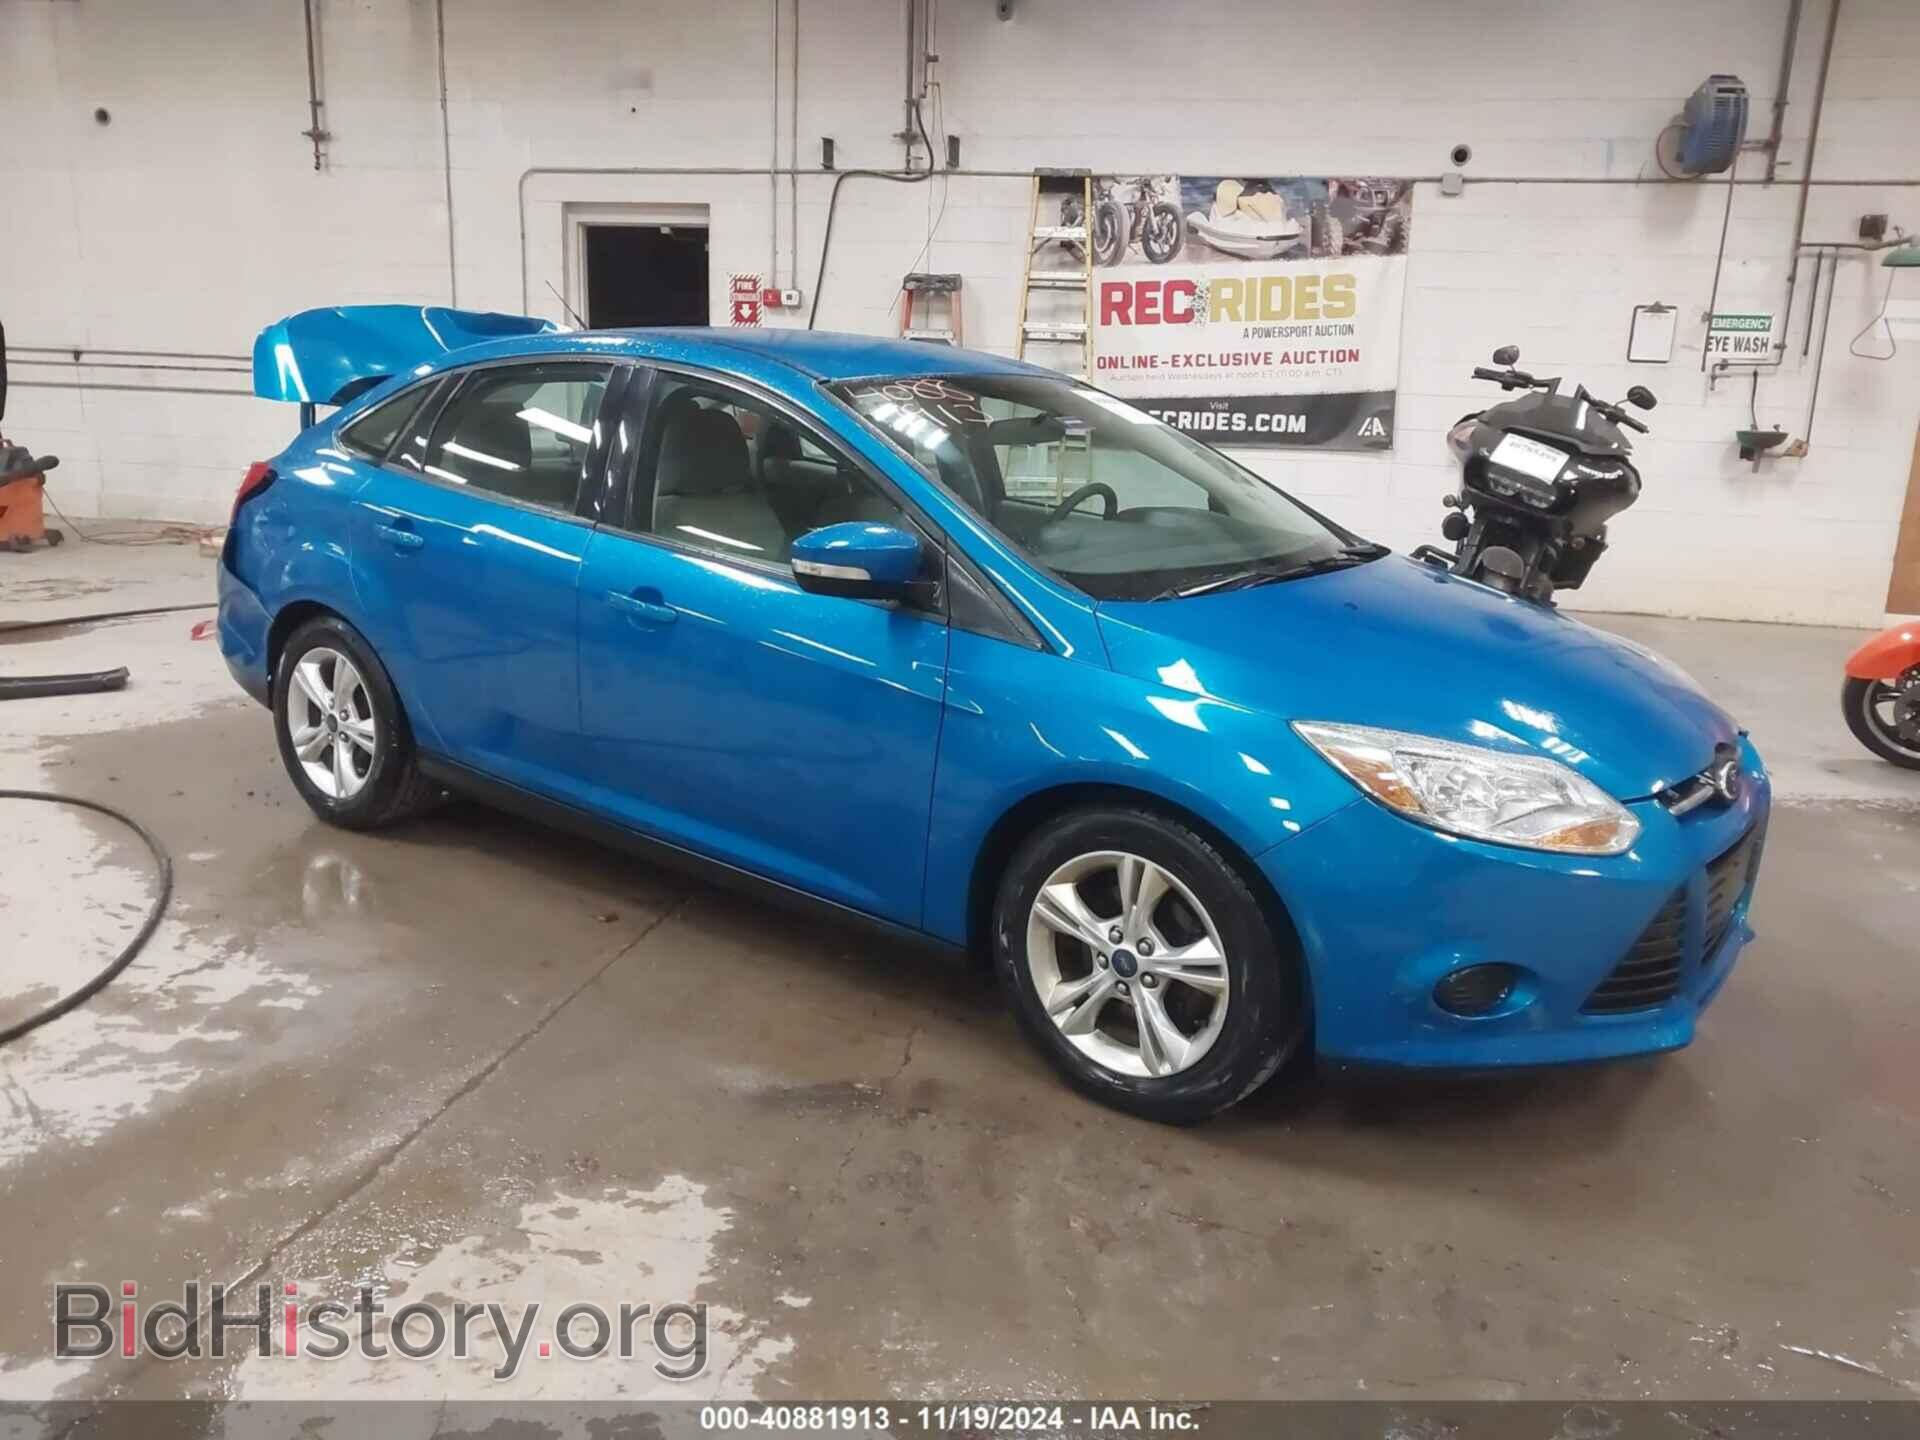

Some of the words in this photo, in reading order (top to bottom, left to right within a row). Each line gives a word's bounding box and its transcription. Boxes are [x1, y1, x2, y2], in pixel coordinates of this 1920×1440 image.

[1100, 279, 1195, 325] REC
[1209, 273, 1356, 322] RIDES
[1243, 328, 1249, 339] A
[1251, 325, 1312, 339] POWERSPORT
[1315, 323, 1354, 336] AUCTION
[1712, 318, 1771, 329] EMERGENCY
[1706, 336, 1730, 352] EYE
[1734, 336, 1769, 353] WASH
[1097, 351, 1273, 369] ONLINE-EXCLUSIVE
[1279, 348, 1360, 365] AUCTION
[1209, 401, 1230, 410] Visit
[1148, 410, 1306, 433] CRIDES.COM
